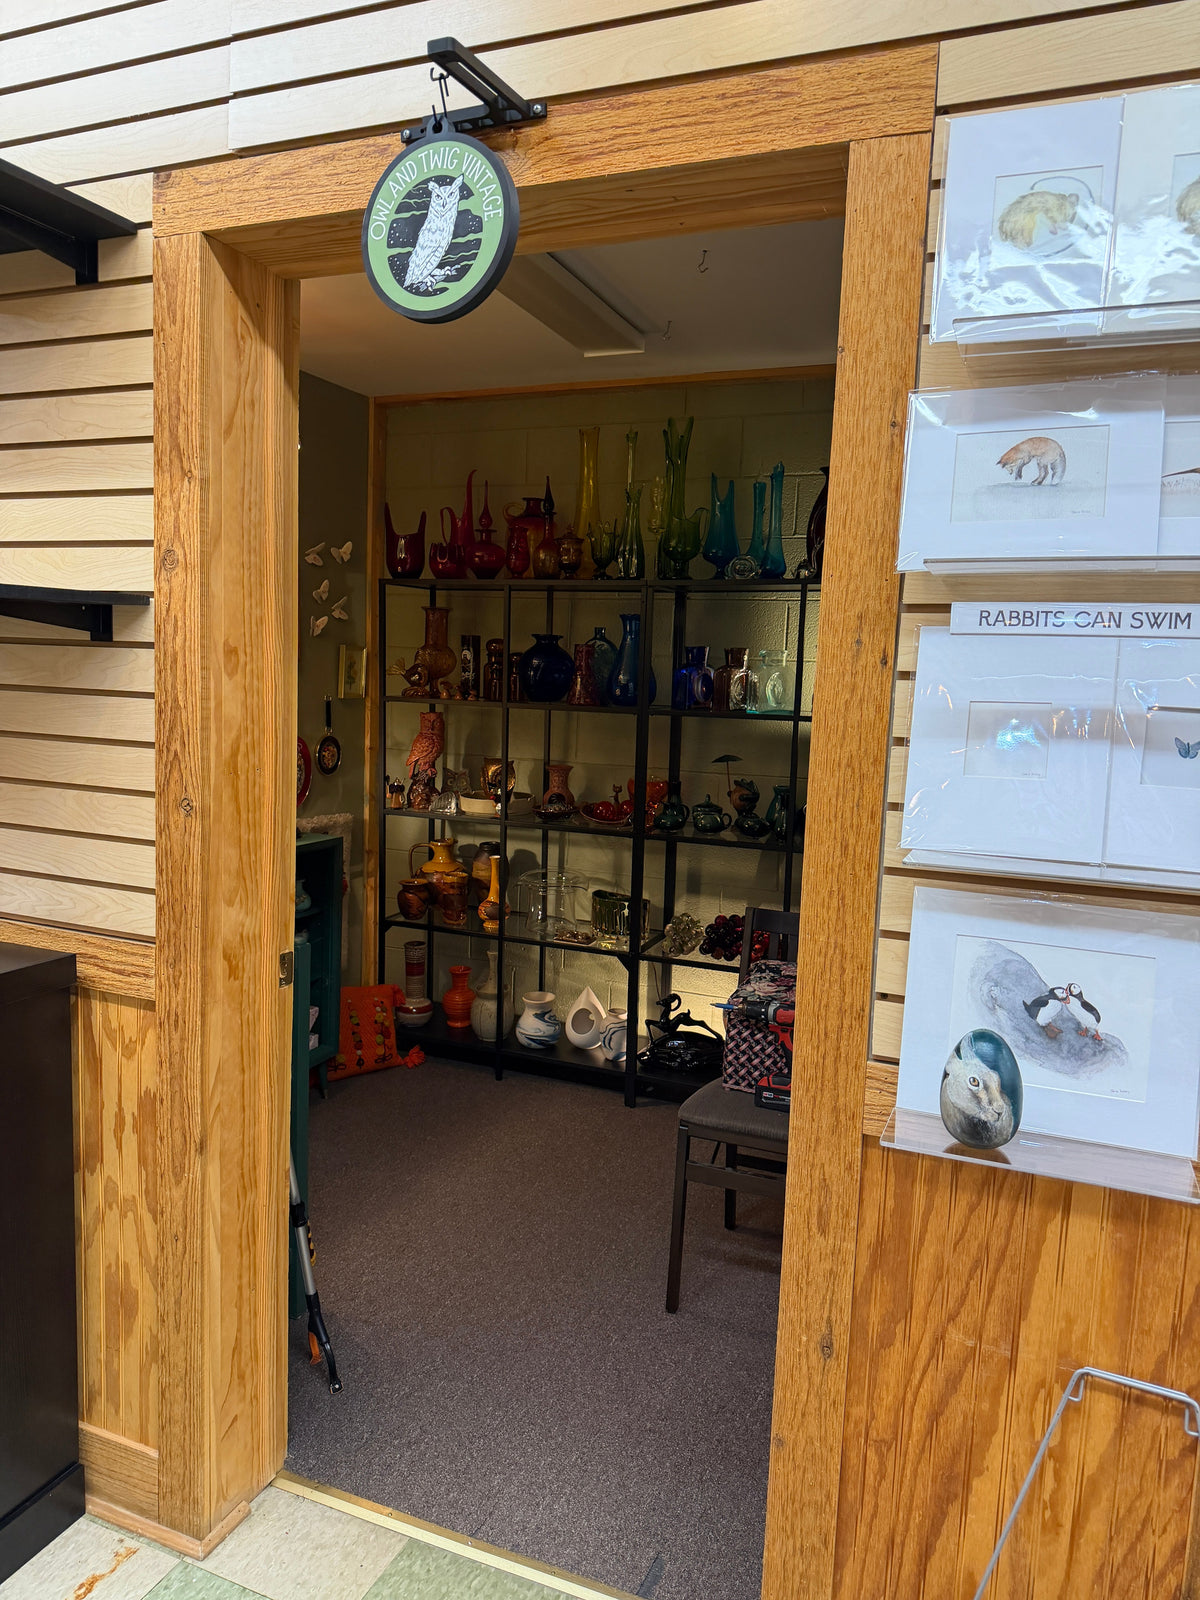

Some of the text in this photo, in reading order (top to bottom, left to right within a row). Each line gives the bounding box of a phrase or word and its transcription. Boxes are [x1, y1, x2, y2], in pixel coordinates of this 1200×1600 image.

[370, 147, 502, 240] OWL AND TWIG VINTAGE
[978, 609, 1192, 630] RABBITS CAN SWIM
